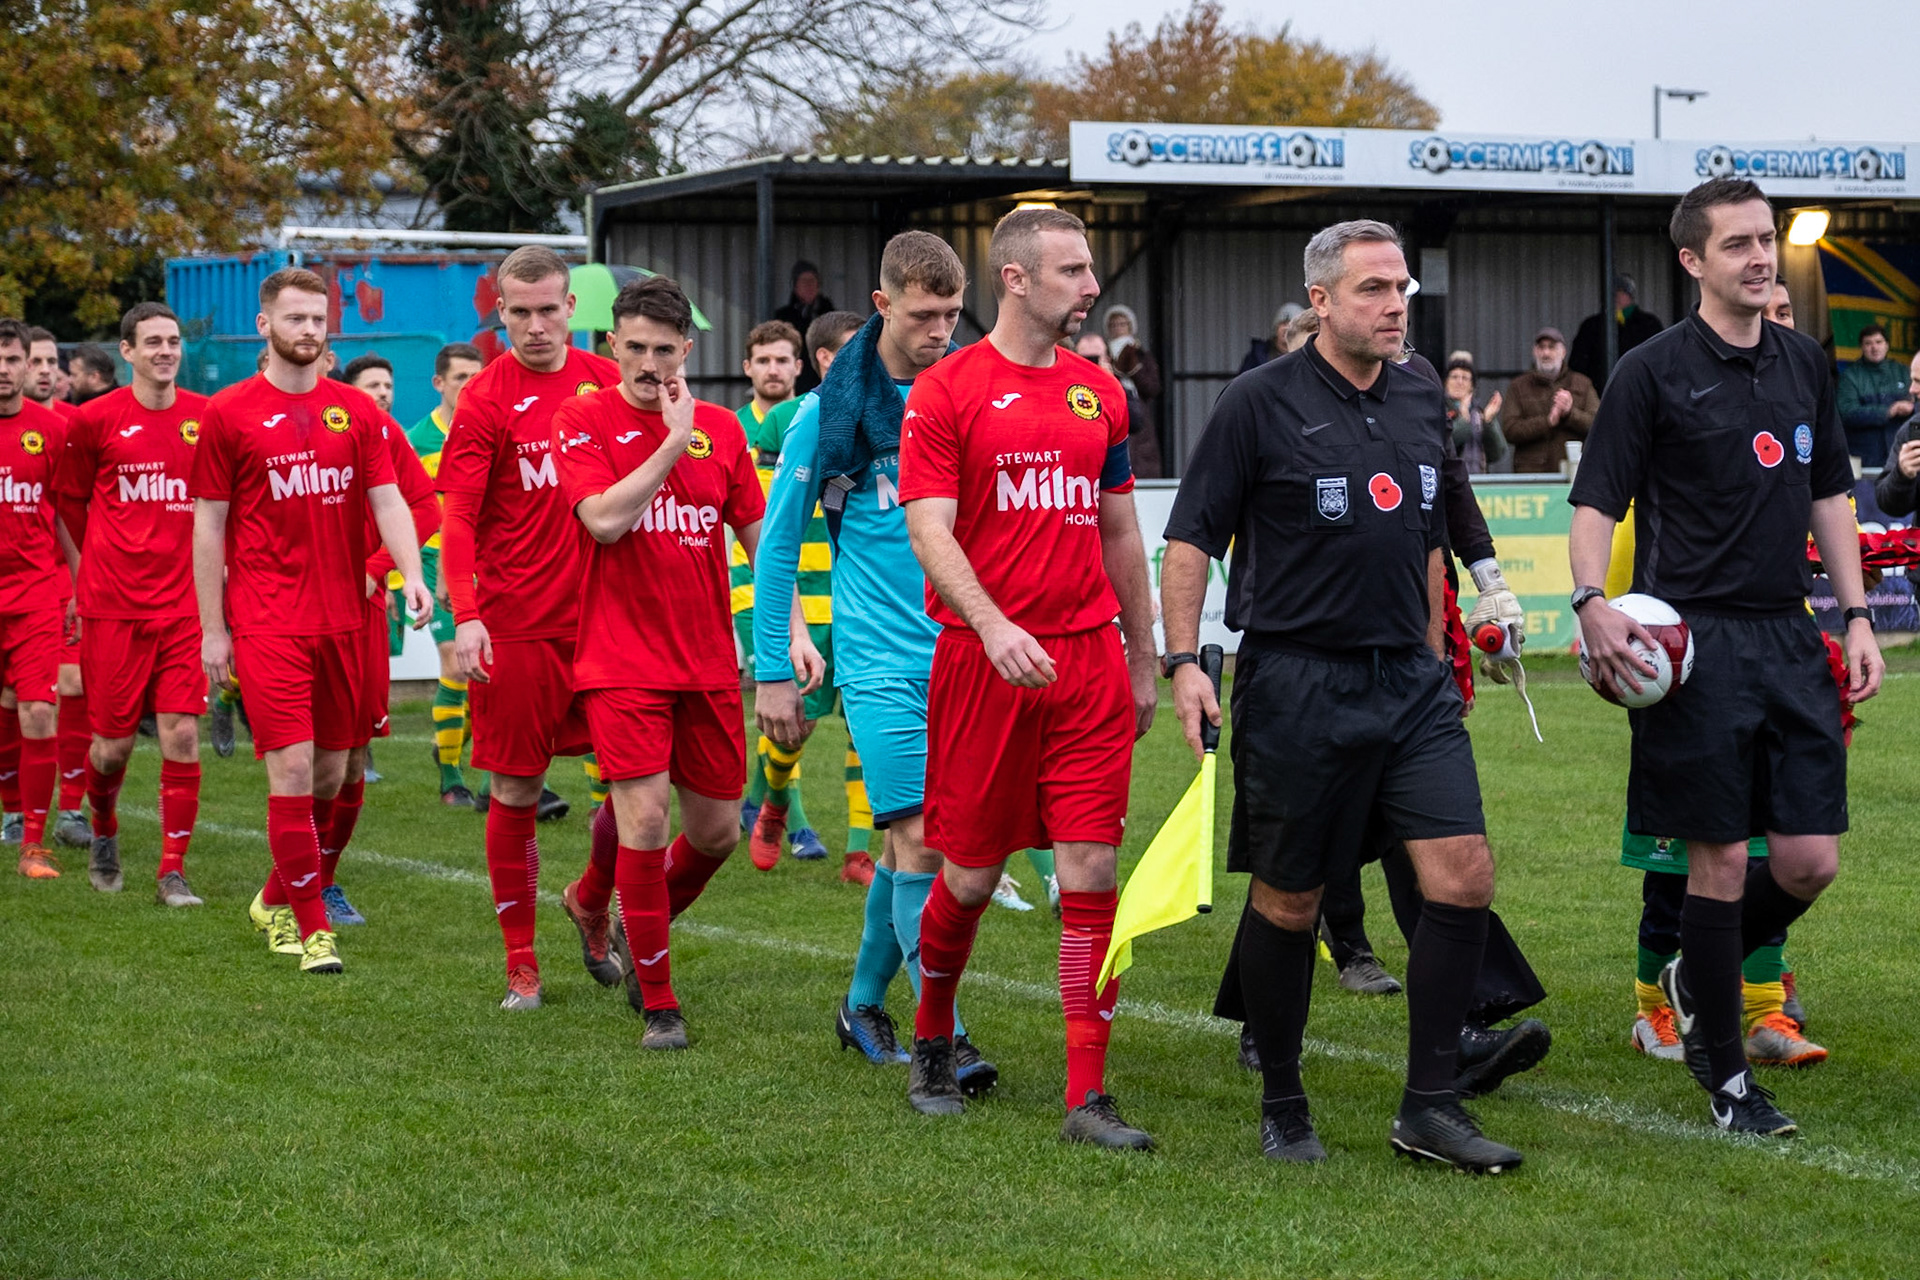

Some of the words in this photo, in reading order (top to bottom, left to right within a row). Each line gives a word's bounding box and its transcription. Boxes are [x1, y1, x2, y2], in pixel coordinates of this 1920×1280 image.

[517, 440, 549, 454] STEW
[265, 450, 315, 468] STEWART
[996, 450, 1061, 466] STEWART
[117, 462, 165, 473] STEWART
[118, 472, 193, 503] Miln
[268, 462, 353, 501] Milne
